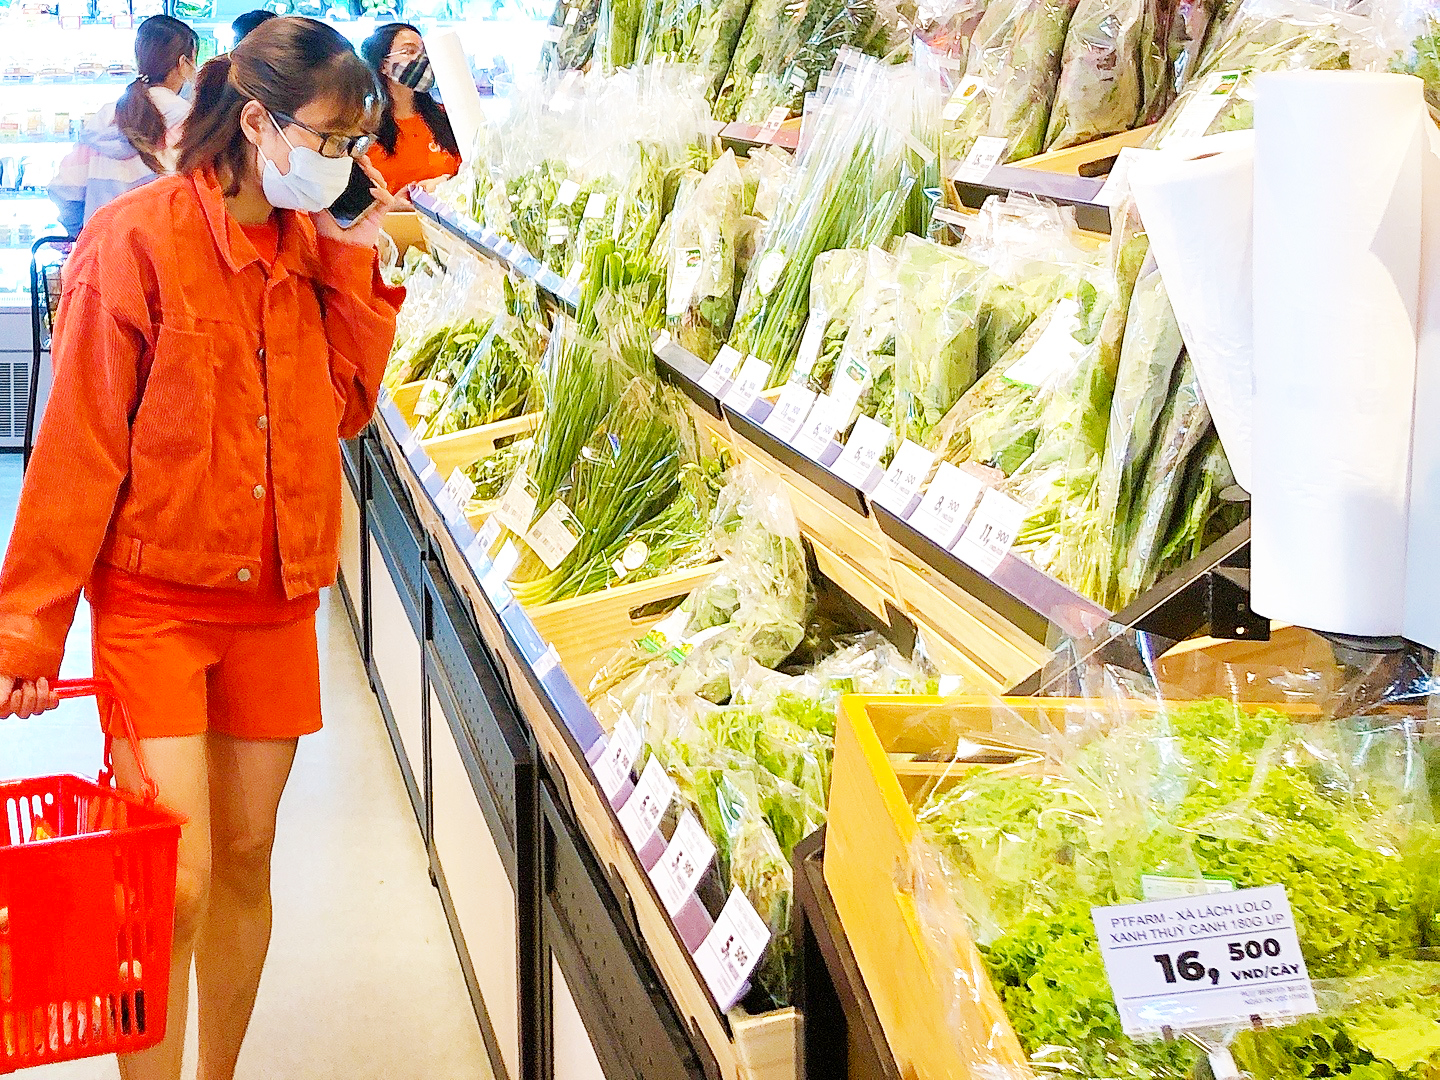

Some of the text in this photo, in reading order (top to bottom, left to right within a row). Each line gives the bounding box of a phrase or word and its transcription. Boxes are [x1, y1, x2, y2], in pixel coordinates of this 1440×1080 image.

[1110, 930, 1147, 943] XANH
[1231, 916, 1264, 931] 180G
[1266, 912, 1286, 926] UP
[1111, 914, 1166, 928] PTFARM
[1236, 899, 1273, 915] LOLO
[1154, 938, 1282, 985] 16, 500
